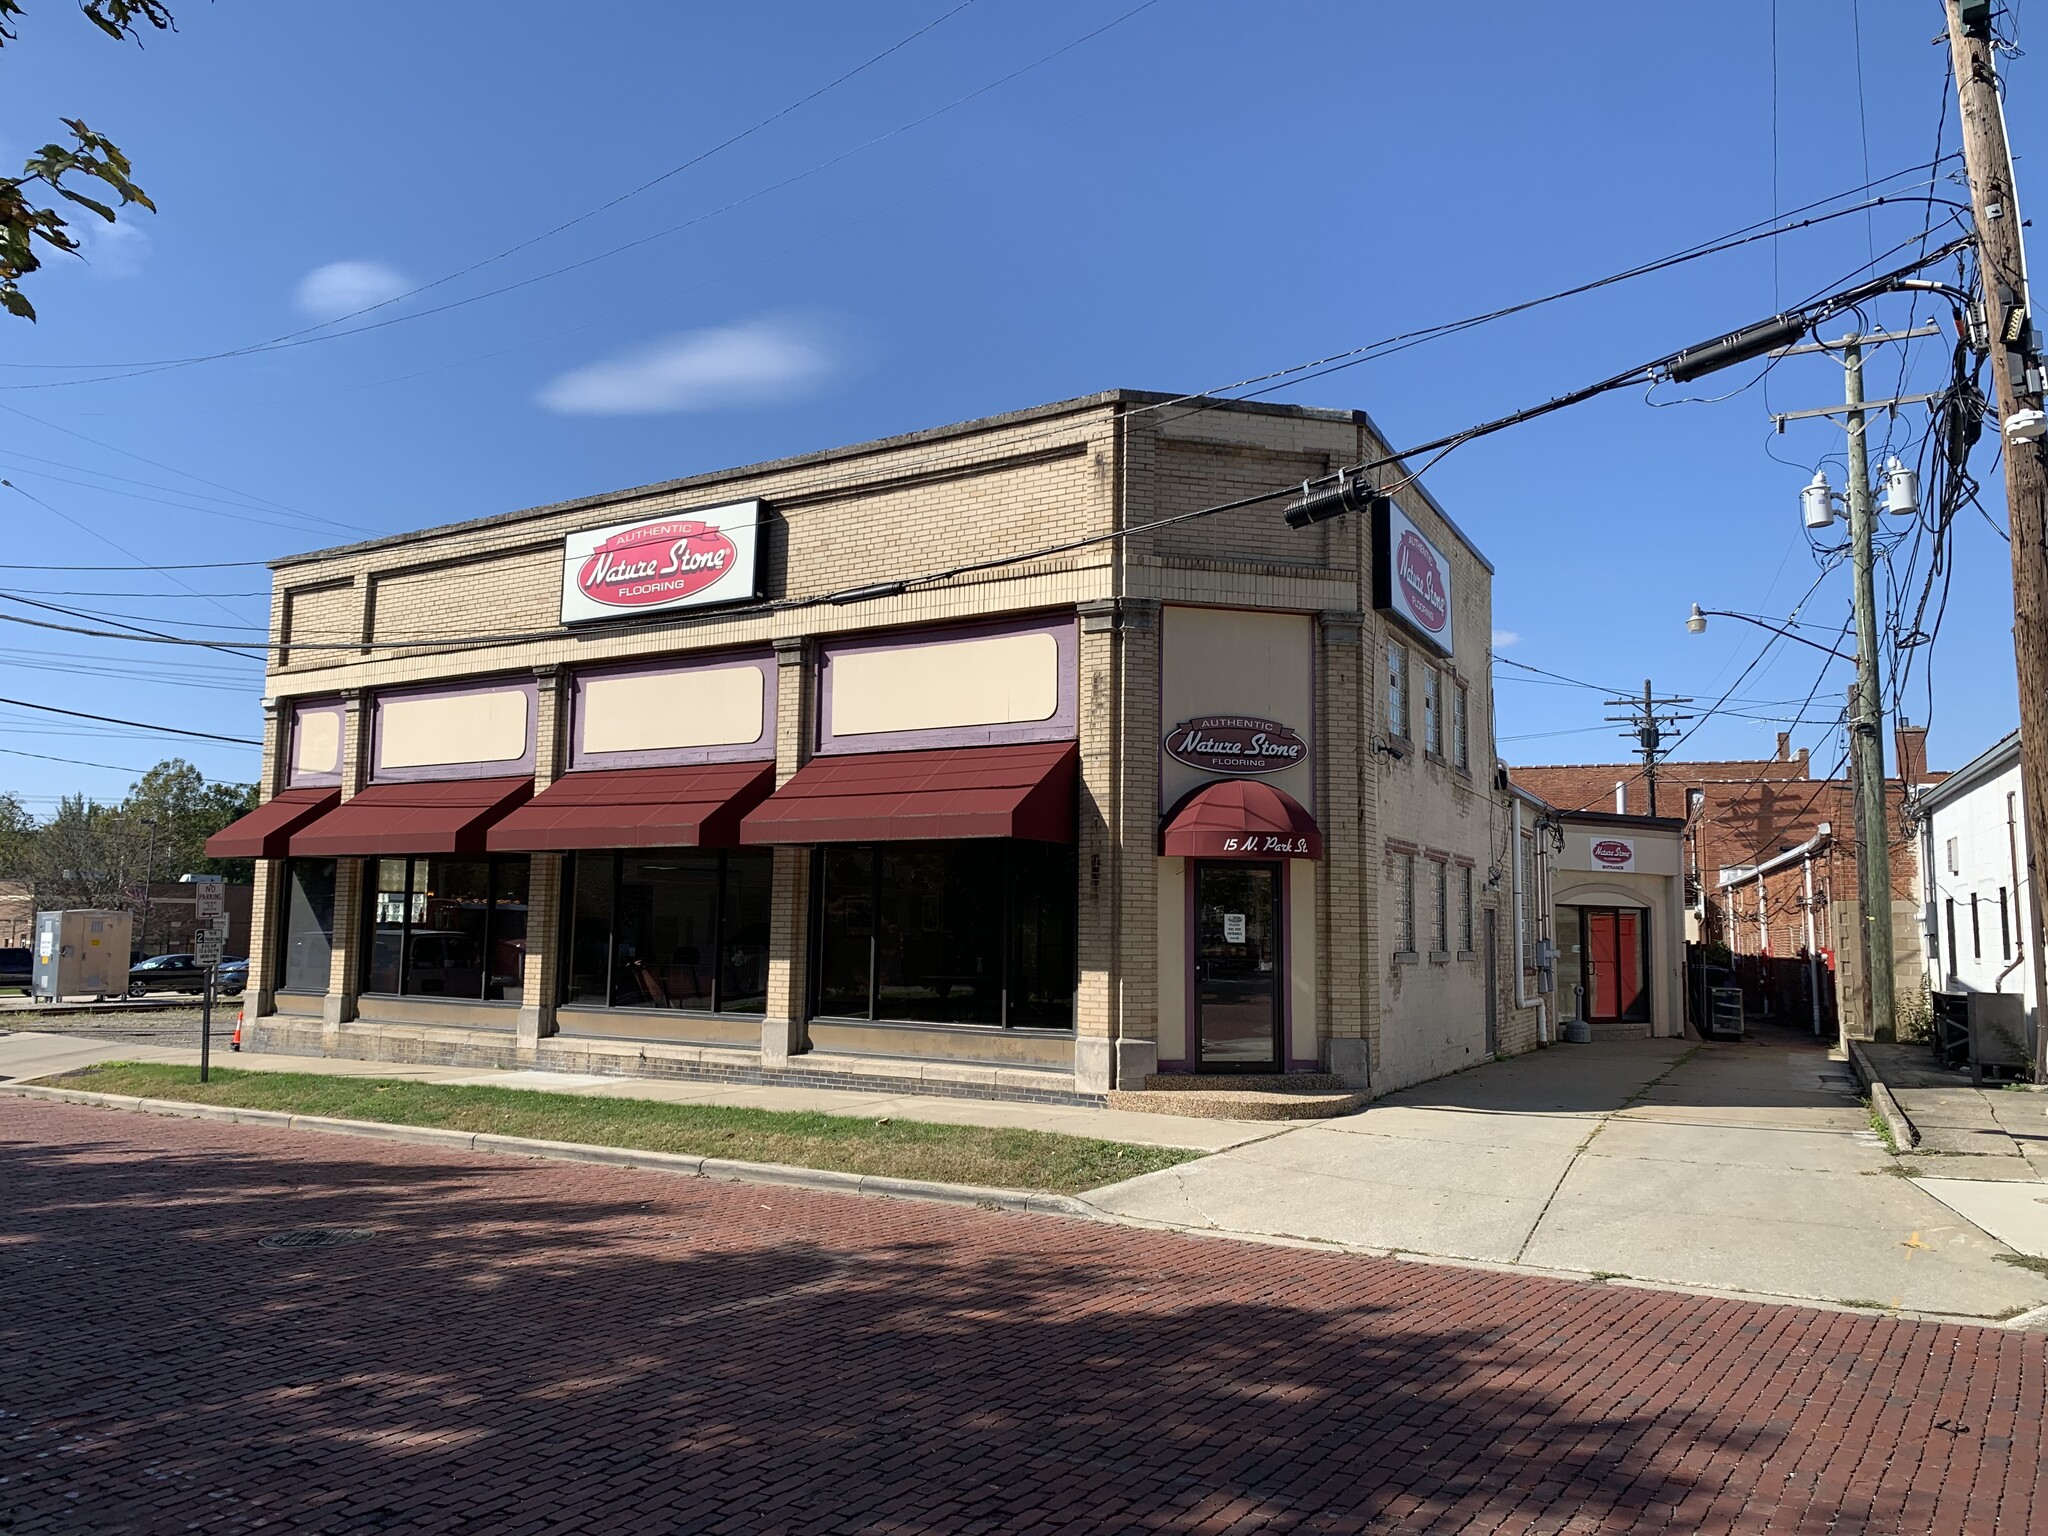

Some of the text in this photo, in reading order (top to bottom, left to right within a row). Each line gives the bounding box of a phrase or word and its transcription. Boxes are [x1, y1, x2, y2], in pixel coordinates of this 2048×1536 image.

[616, 524, 692, 546] AUTHENTIC
[585, 538, 726, 587] Nature Stone
[1400, 545, 1445, 613] Nature Stone
[619, 579, 685, 598] FLOORING
[1201, 718, 1274, 731] AUTHENTIC
[1177, 730, 1299, 757] Nature Stone
[1212, 758, 1266, 767] FLOORING
[1223, 836, 1308, 853] 15 N. Park St.
[205, 885, 216, 893] NO
[197, 932, 204, 943] 2
